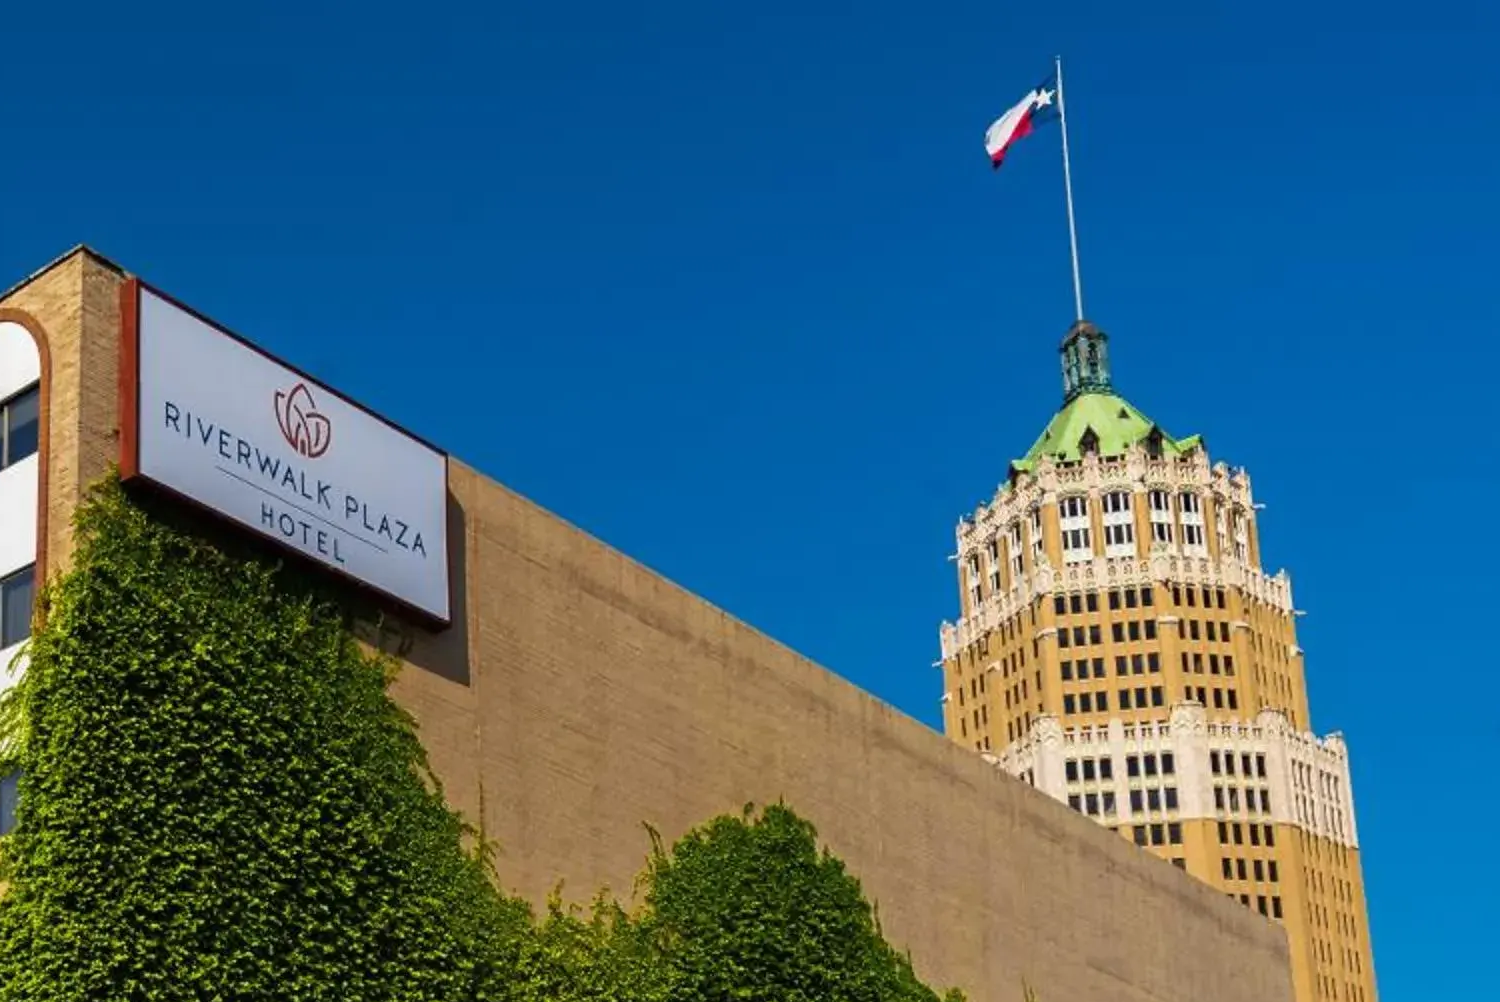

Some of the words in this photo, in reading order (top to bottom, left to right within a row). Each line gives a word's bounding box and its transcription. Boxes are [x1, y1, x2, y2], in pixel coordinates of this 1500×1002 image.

[164, 400, 331, 510] RIVERWALK
[345, 495, 427, 558] PLAZA
[260, 501, 345, 563] HOTEL
